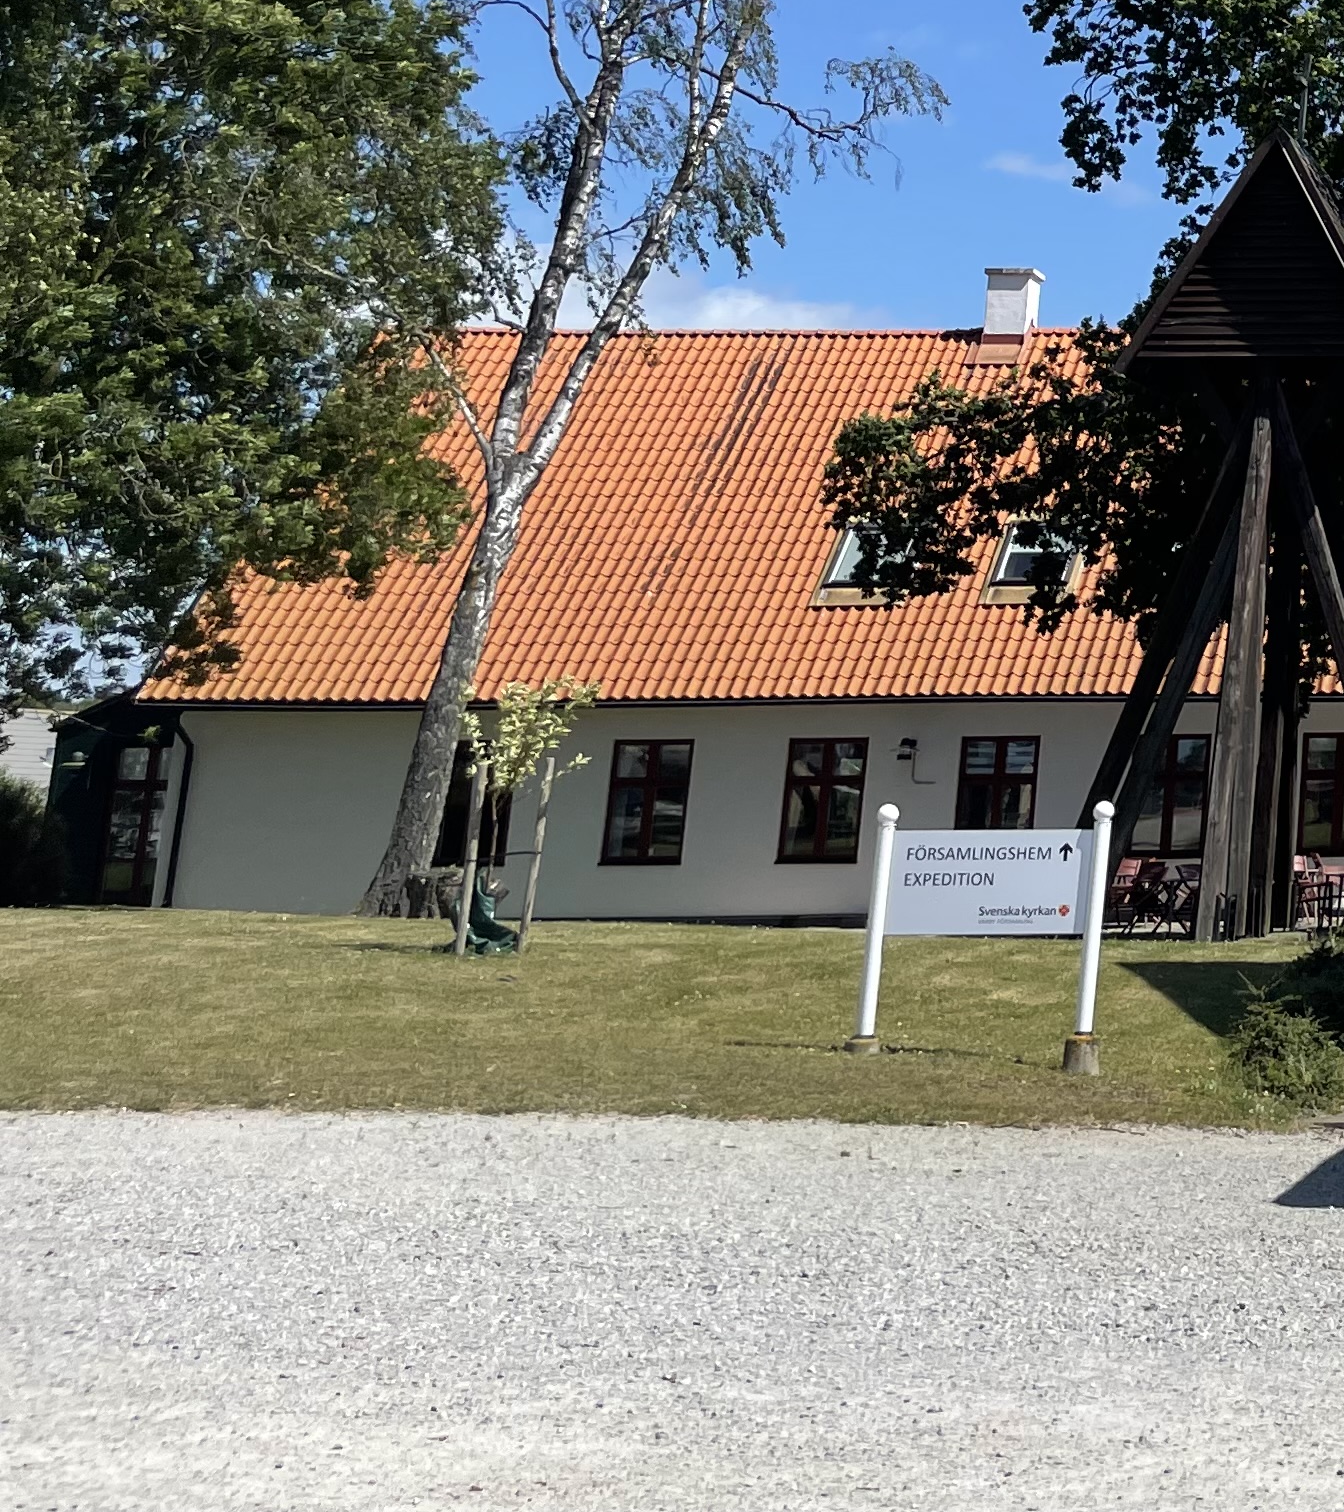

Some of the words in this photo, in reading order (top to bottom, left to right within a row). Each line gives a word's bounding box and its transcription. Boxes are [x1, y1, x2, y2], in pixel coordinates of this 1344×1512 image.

[906, 844, 1052, 861] FÖRSAMLINGSHEM
[904, 872, 995, 887] EXPEDITION
[978, 906, 1020, 916] Svenska
[1021, 905, 1056, 918] kyrkan
